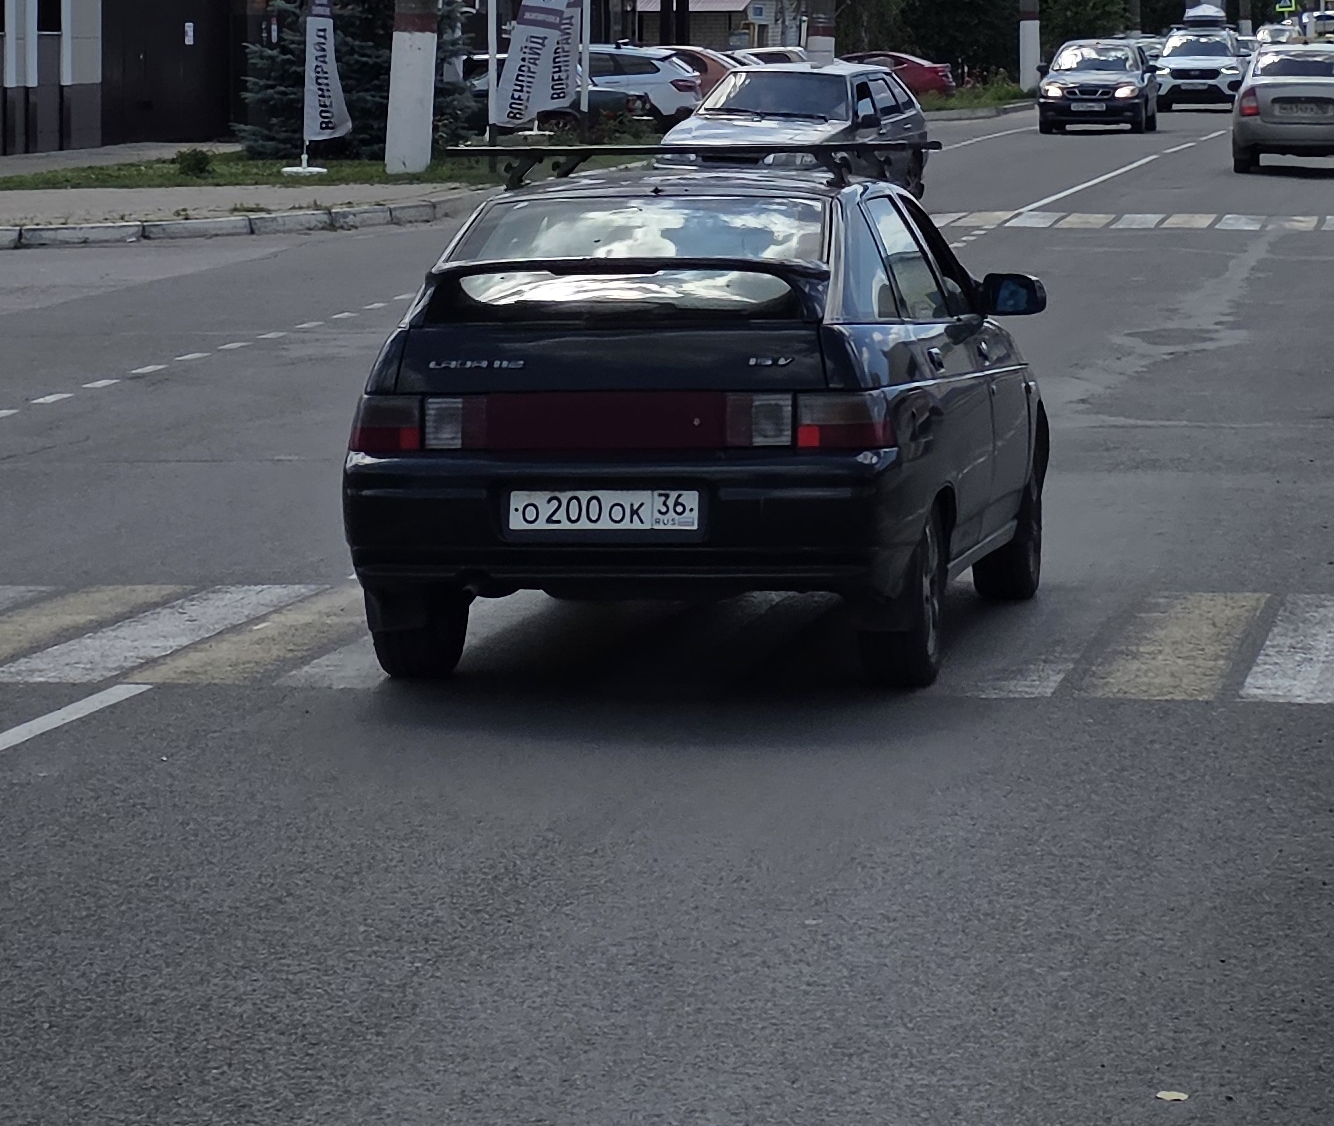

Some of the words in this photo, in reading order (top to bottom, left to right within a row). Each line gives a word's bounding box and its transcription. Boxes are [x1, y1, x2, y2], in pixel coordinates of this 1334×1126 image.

[507, 35, 548, 120] ВОЕНПРАЙД
[657, 493, 686, 516] 36
[655, 518, 677, 526] RUS
